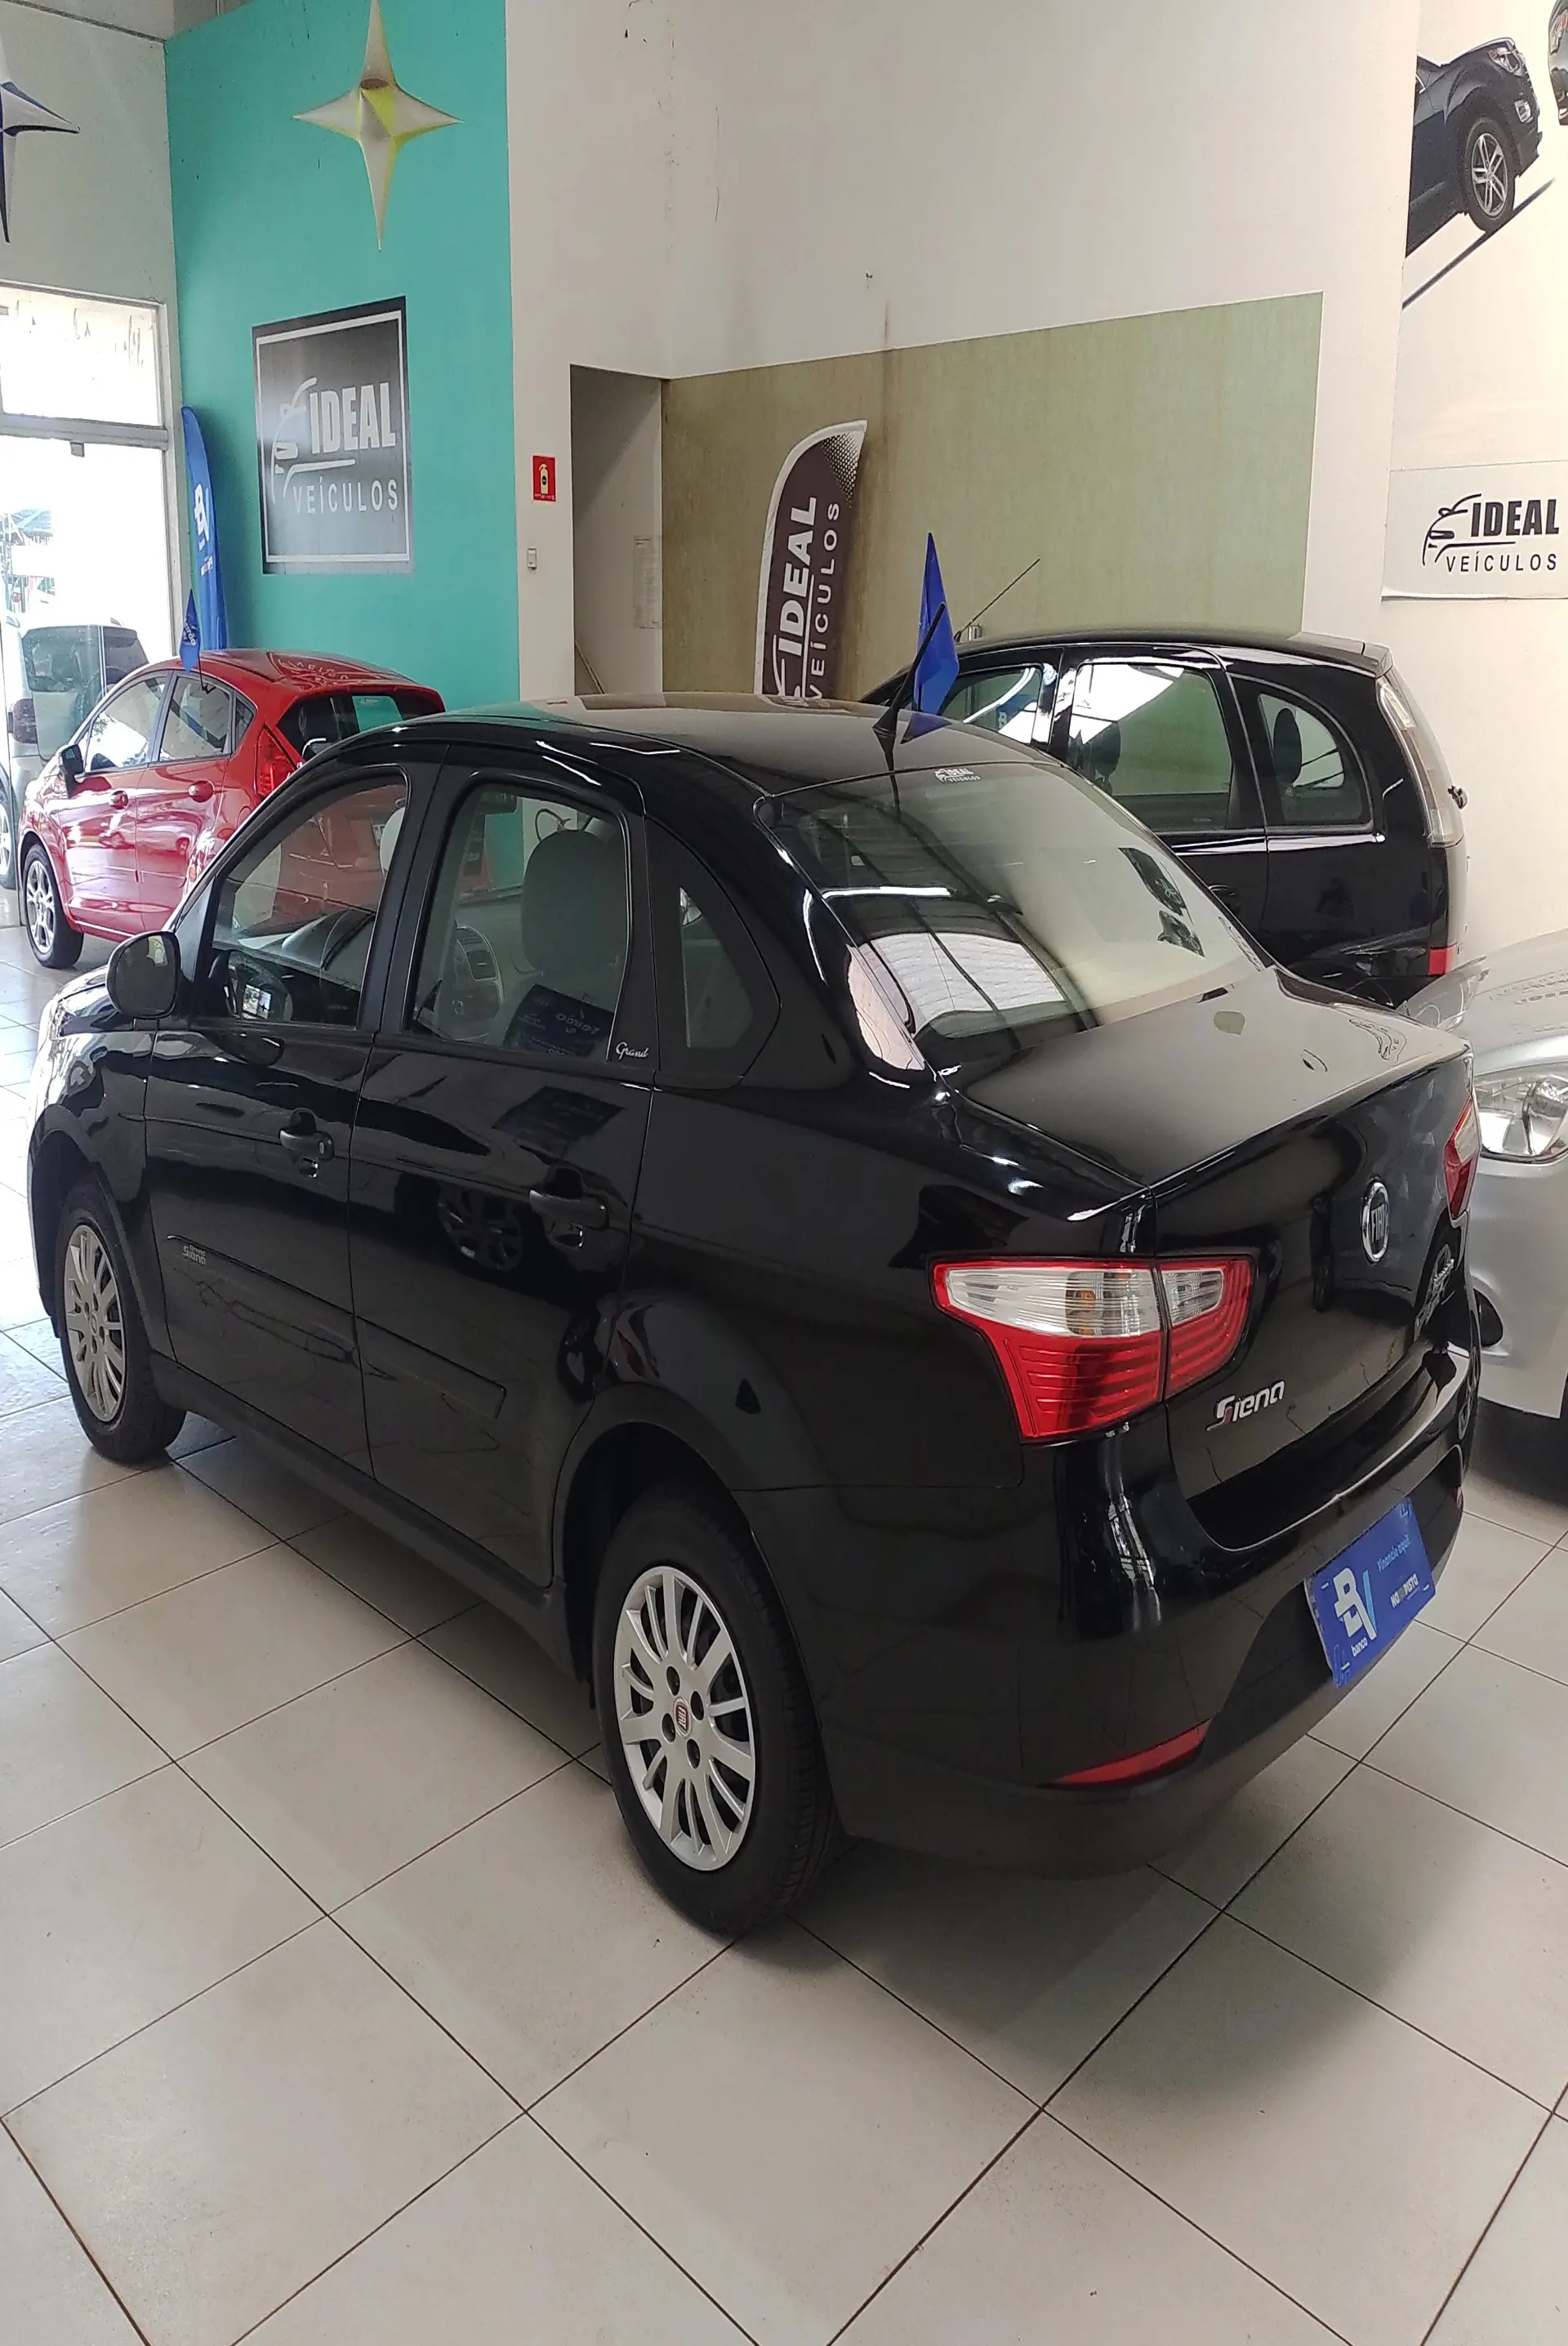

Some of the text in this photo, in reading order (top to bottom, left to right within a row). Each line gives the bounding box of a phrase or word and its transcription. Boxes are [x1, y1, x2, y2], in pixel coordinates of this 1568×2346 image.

[310, 381, 396, 454] IDEAL
[292, 476, 399, 514] VEÍCULOS
[1471, 499, 1560, 537] IDEAL
[777, 497, 817, 657] IDEAL
[1446, 551, 1557, 573] VEÍCULOS
[808, 502, 840, 700] VEÍCULOS
[616, 1041, 649, 1060] Grand
[1206, 1380, 1285, 1432] Siena
[1350, 1637, 1368, 1657] banco
